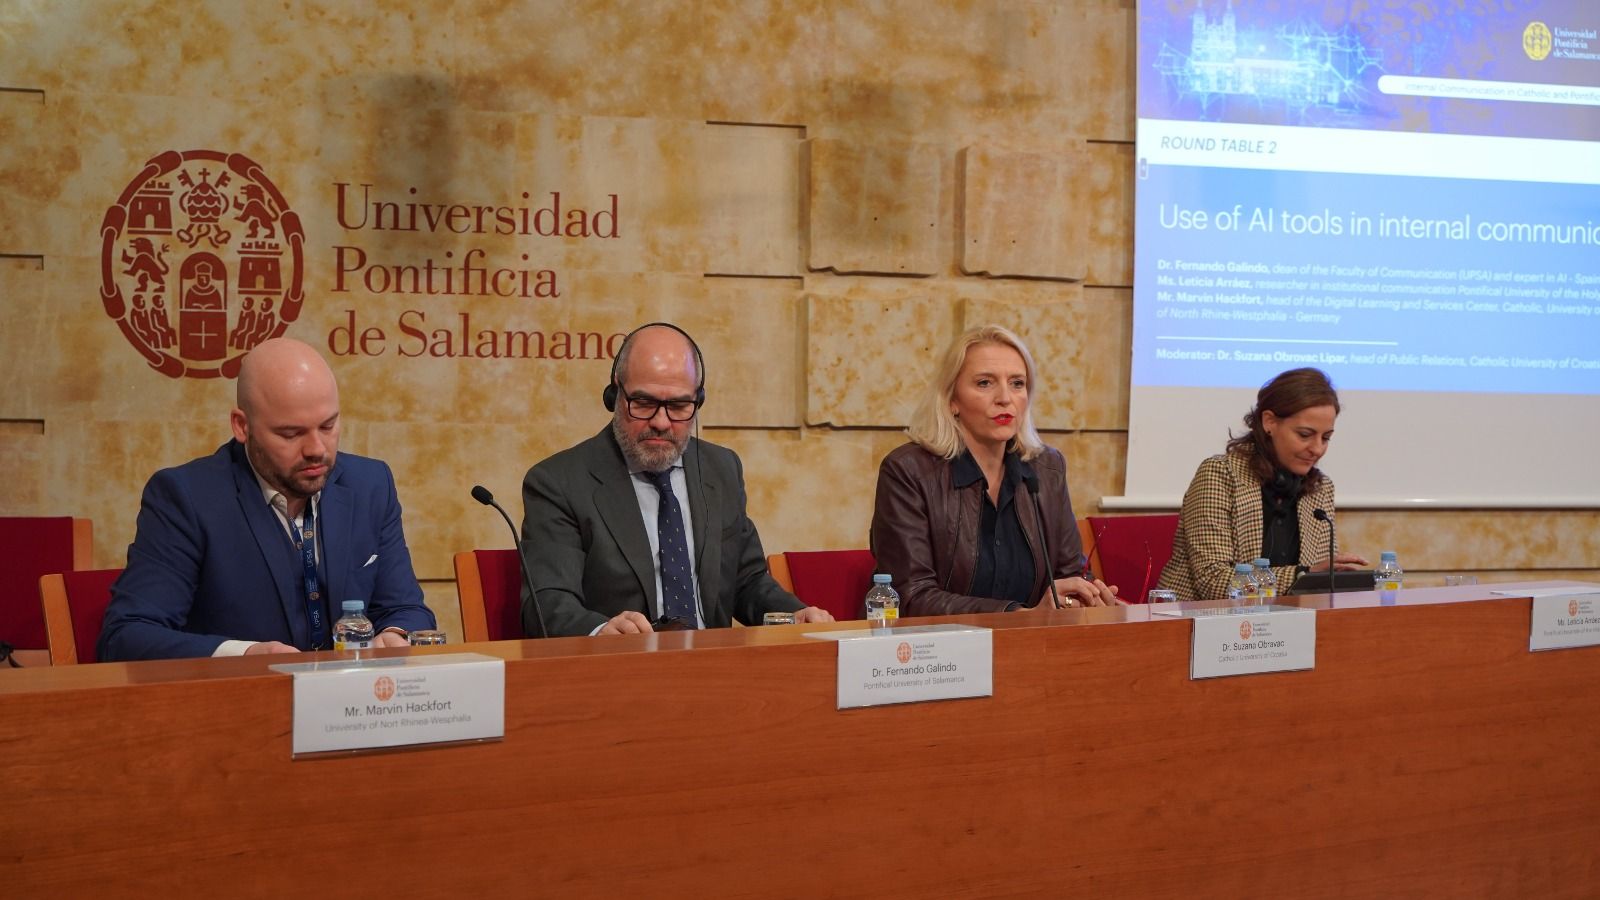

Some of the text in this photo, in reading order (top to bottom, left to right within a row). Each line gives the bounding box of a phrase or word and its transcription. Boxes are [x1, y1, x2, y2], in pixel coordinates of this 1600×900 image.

[1563, 48, 1600, 59] Salamanc
[1160, 136, 1278, 154] ROUND TABLE 2
[332, 182, 621, 239] Universidad
[1159, 203, 1208, 230] Use
[1215, 204, 1243, 231] of
[1249, 207, 1274, 232] AI
[1281, 208, 1343, 236] tools
[1350, 211, 1372, 236] in
[1379, 212, 1471, 240] internal
[331, 246, 561, 299] Pontificia
[1157, 259, 1173, 270] Dr.
[1175, 260, 1225, 272] Fernando
[1226, 262, 1270, 274] Galindo,
[1272, 263, 1297, 274] dean
[1300, 264, 1311, 275] of
[1312, 264, 1329, 275] the
[1331, 265, 1365, 278] Faculty
[1367, 266, 1379, 277] of
[1380, 267, 1457, 279] Communication
[1459, 269, 1492, 281] (UPSA)
[1493, 271, 1512, 281] and
[1513, 273, 1544, 284] expert
[1545, 273, 1555, 282] in
[1157, 275, 1176, 286] Ms.
[1179, 276, 1213, 288] Leticia
[1255, 279, 1308, 290] researcher
[1309, 282, 1320, 290] in
[1322, 282, 1380, 292] institutional
[1381, 283, 1457, 295] communication
[1459, 285, 1503, 297] Pontifical
[1504, 287, 1550, 299] University
[1552, 287, 1563, 298] of
[1564, 288, 1580, 299] the
[1157, 291, 1174, 302] Mr.
[1177, 292, 1213, 303] Marvin
[1216, 293, 1263, 306] Hackfort,
[1266, 295, 1291, 306] head
[1293, 296, 1304, 306] of
[1305, 296, 1321, 307] the
[1324, 296, 1357, 309] Digital
[1358, 298, 1400, 311] Learning
[1401, 299, 1421, 310] and
[1423, 300, 1465, 311] Services
[1547, 303, 1593, 316] University
[1156, 307, 1169, 318] of
[1170, 308, 1199, 320] North
[1201, 308, 1287, 322] Rhine-Westphalia
[1296, 311, 1341, 325] Germany
[327, 309, 627, 361] de Salamanc
[1156, 348, 1216, 361] Moderator:
[1217, 349, 1232, 361] Dr.
[1234, 350, 1272, 362] Suzana
[1273, 351, 1318, 363] Obrovac
[1320, 353, 1348, 365] Lipar,
[1350, 353, 1376, 365] head
[1376, 354, 1388, 365] of
[1389, 354, 1420, 366] Public
[1470, 356, 1510, 368] Catholic
[1511, 357, 1558, 370] University
[1559, 357, 1570, 369] of
[1222, 643, 1232, 652] Dr.
[872, 662, 957, 678] Dr. Fernando Galindo
[894, 678, 923, 689] University
[924, 677, 931, 686] of
[344, 700, 452, 718] Mr. Marvin Hackfort
[325, 722, 367, 733] University
[369, 721, 379, 731] of
